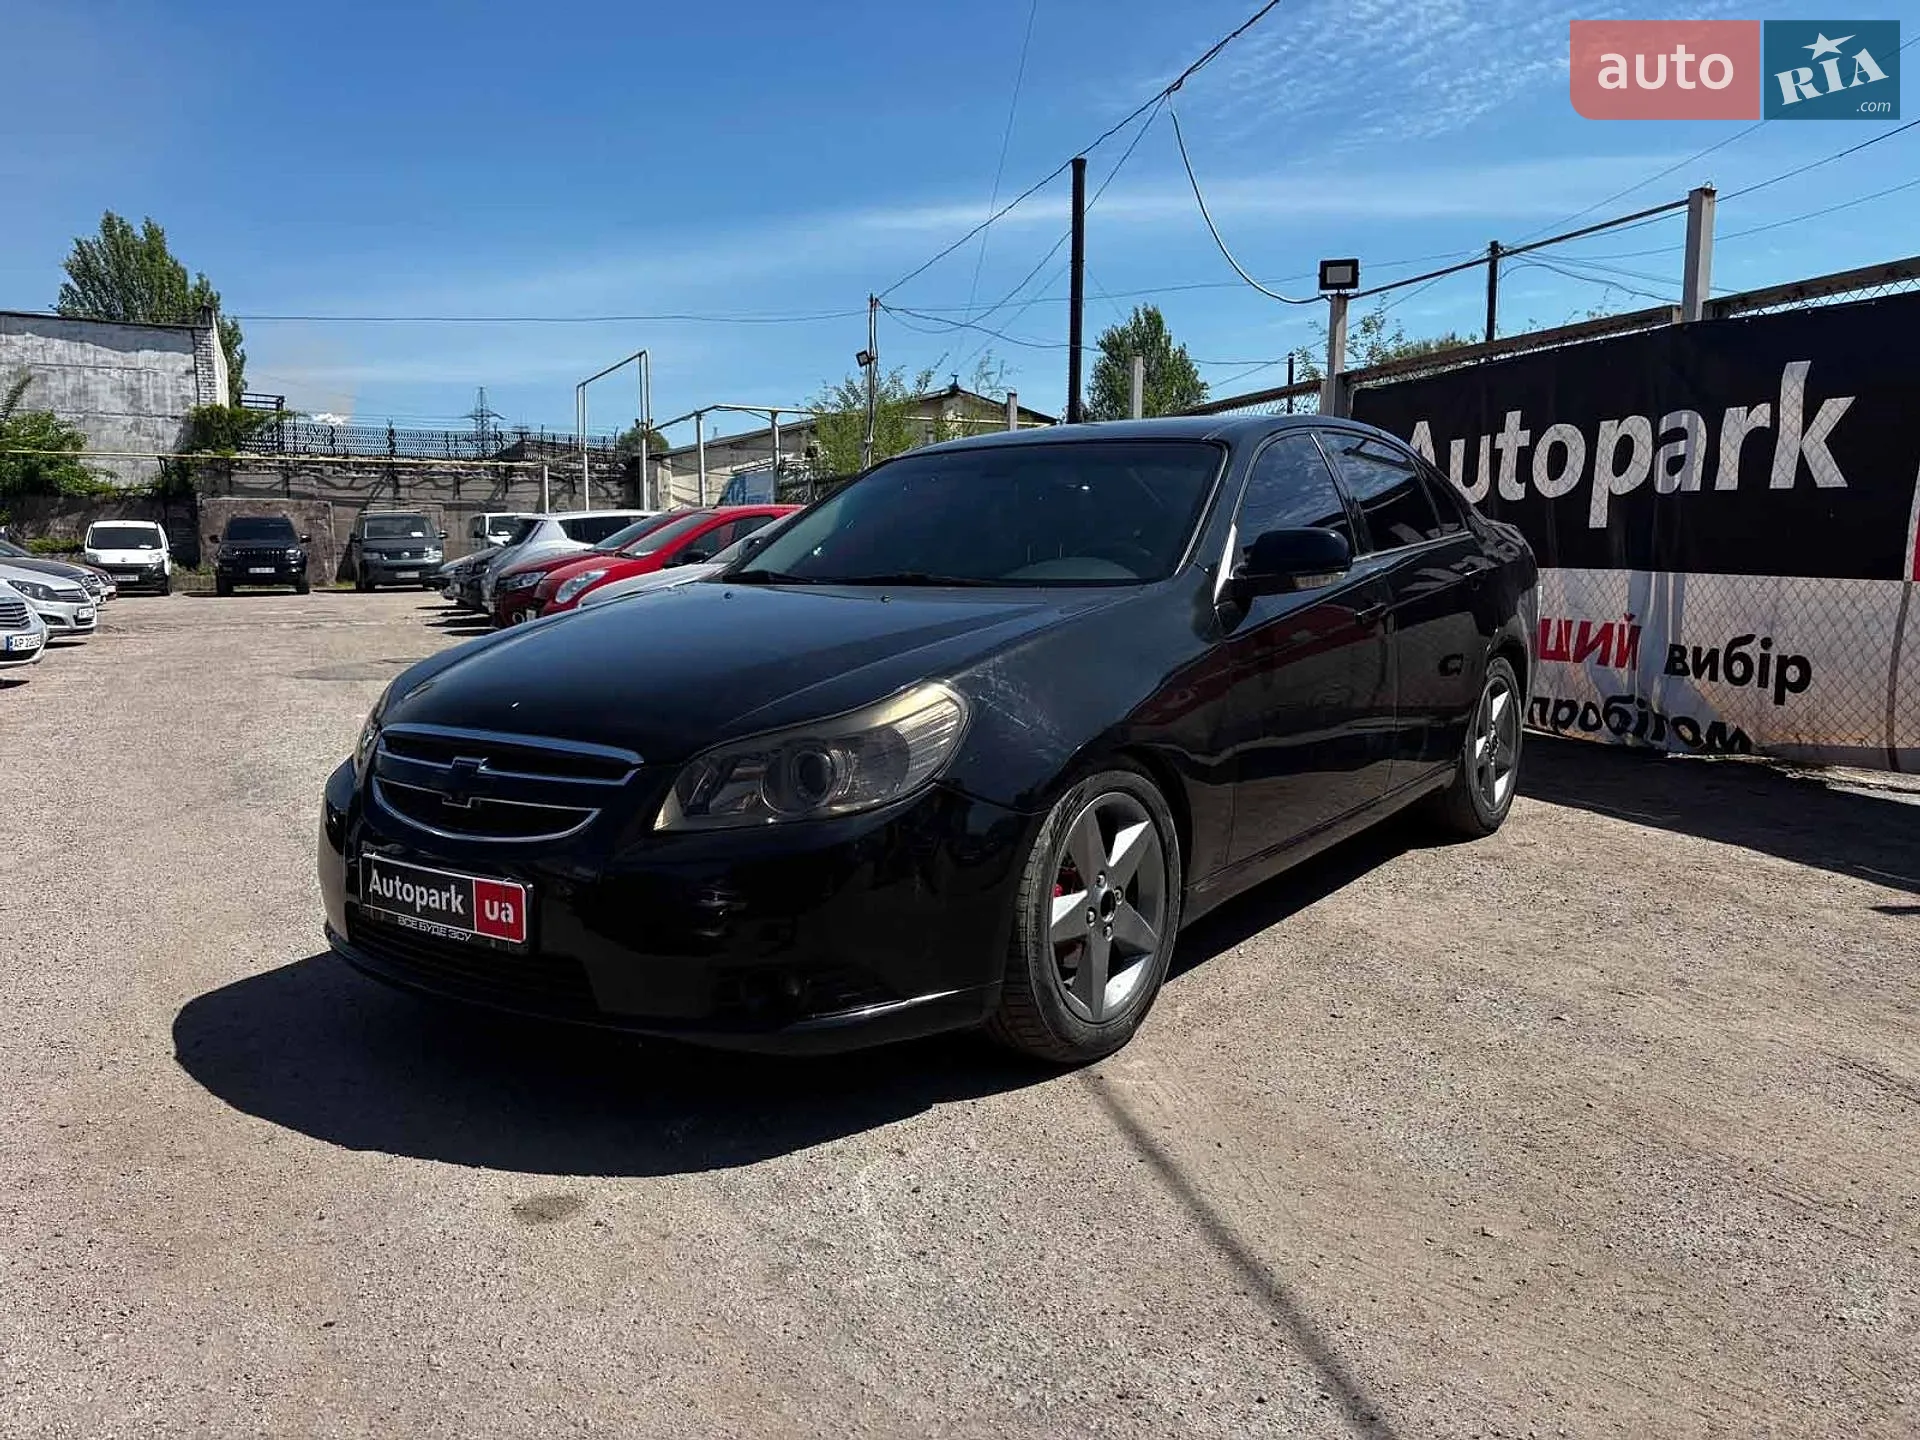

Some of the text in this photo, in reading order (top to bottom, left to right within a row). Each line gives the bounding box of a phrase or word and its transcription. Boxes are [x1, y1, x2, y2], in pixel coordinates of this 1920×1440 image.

[1406, 360, 1856, 529] Autopark
[1664, 634, 1812, 705] вибір
[369, 869, 514, 924] Autopark ua
